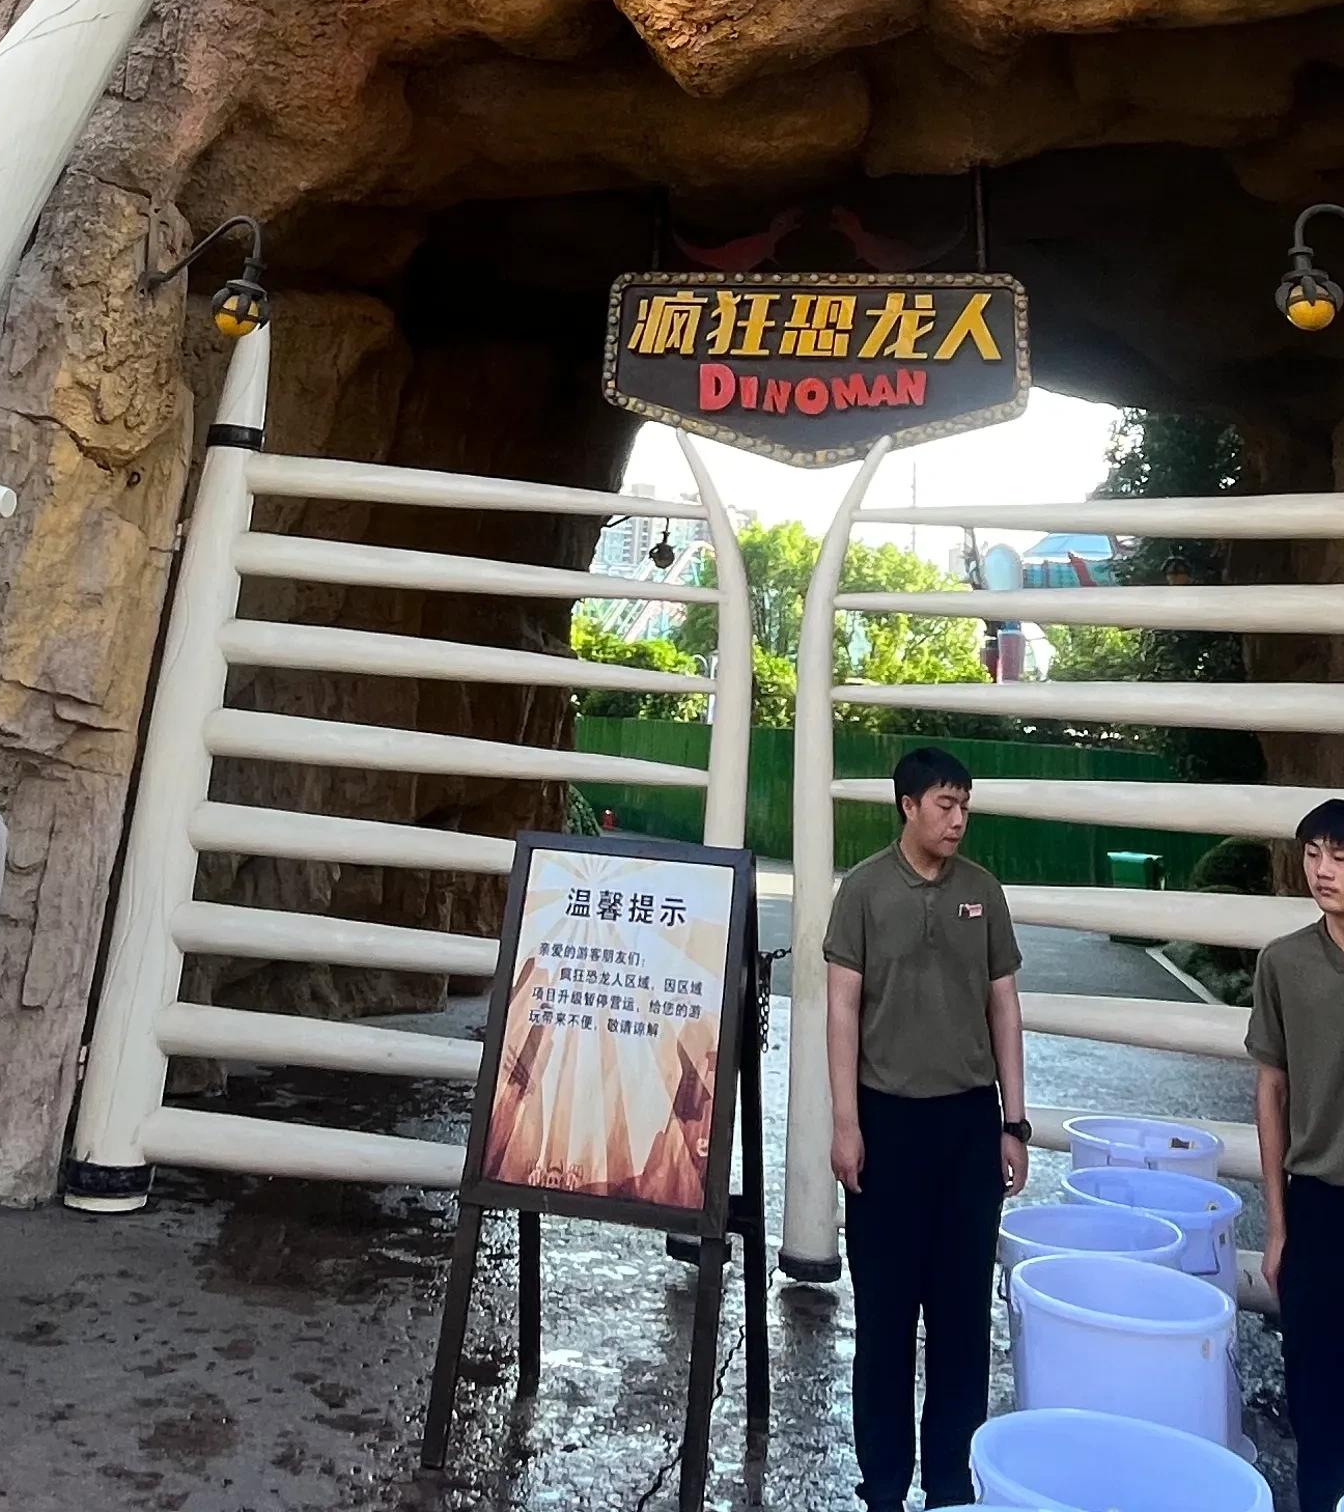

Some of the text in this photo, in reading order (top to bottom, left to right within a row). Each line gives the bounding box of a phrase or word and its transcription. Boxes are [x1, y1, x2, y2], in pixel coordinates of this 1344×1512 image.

[627, 290, 1003, 361] 疯狂恐龙人
[698, 363, 929, 416] DINOMAN
[565, 887, 687, 927] 温馨提示
